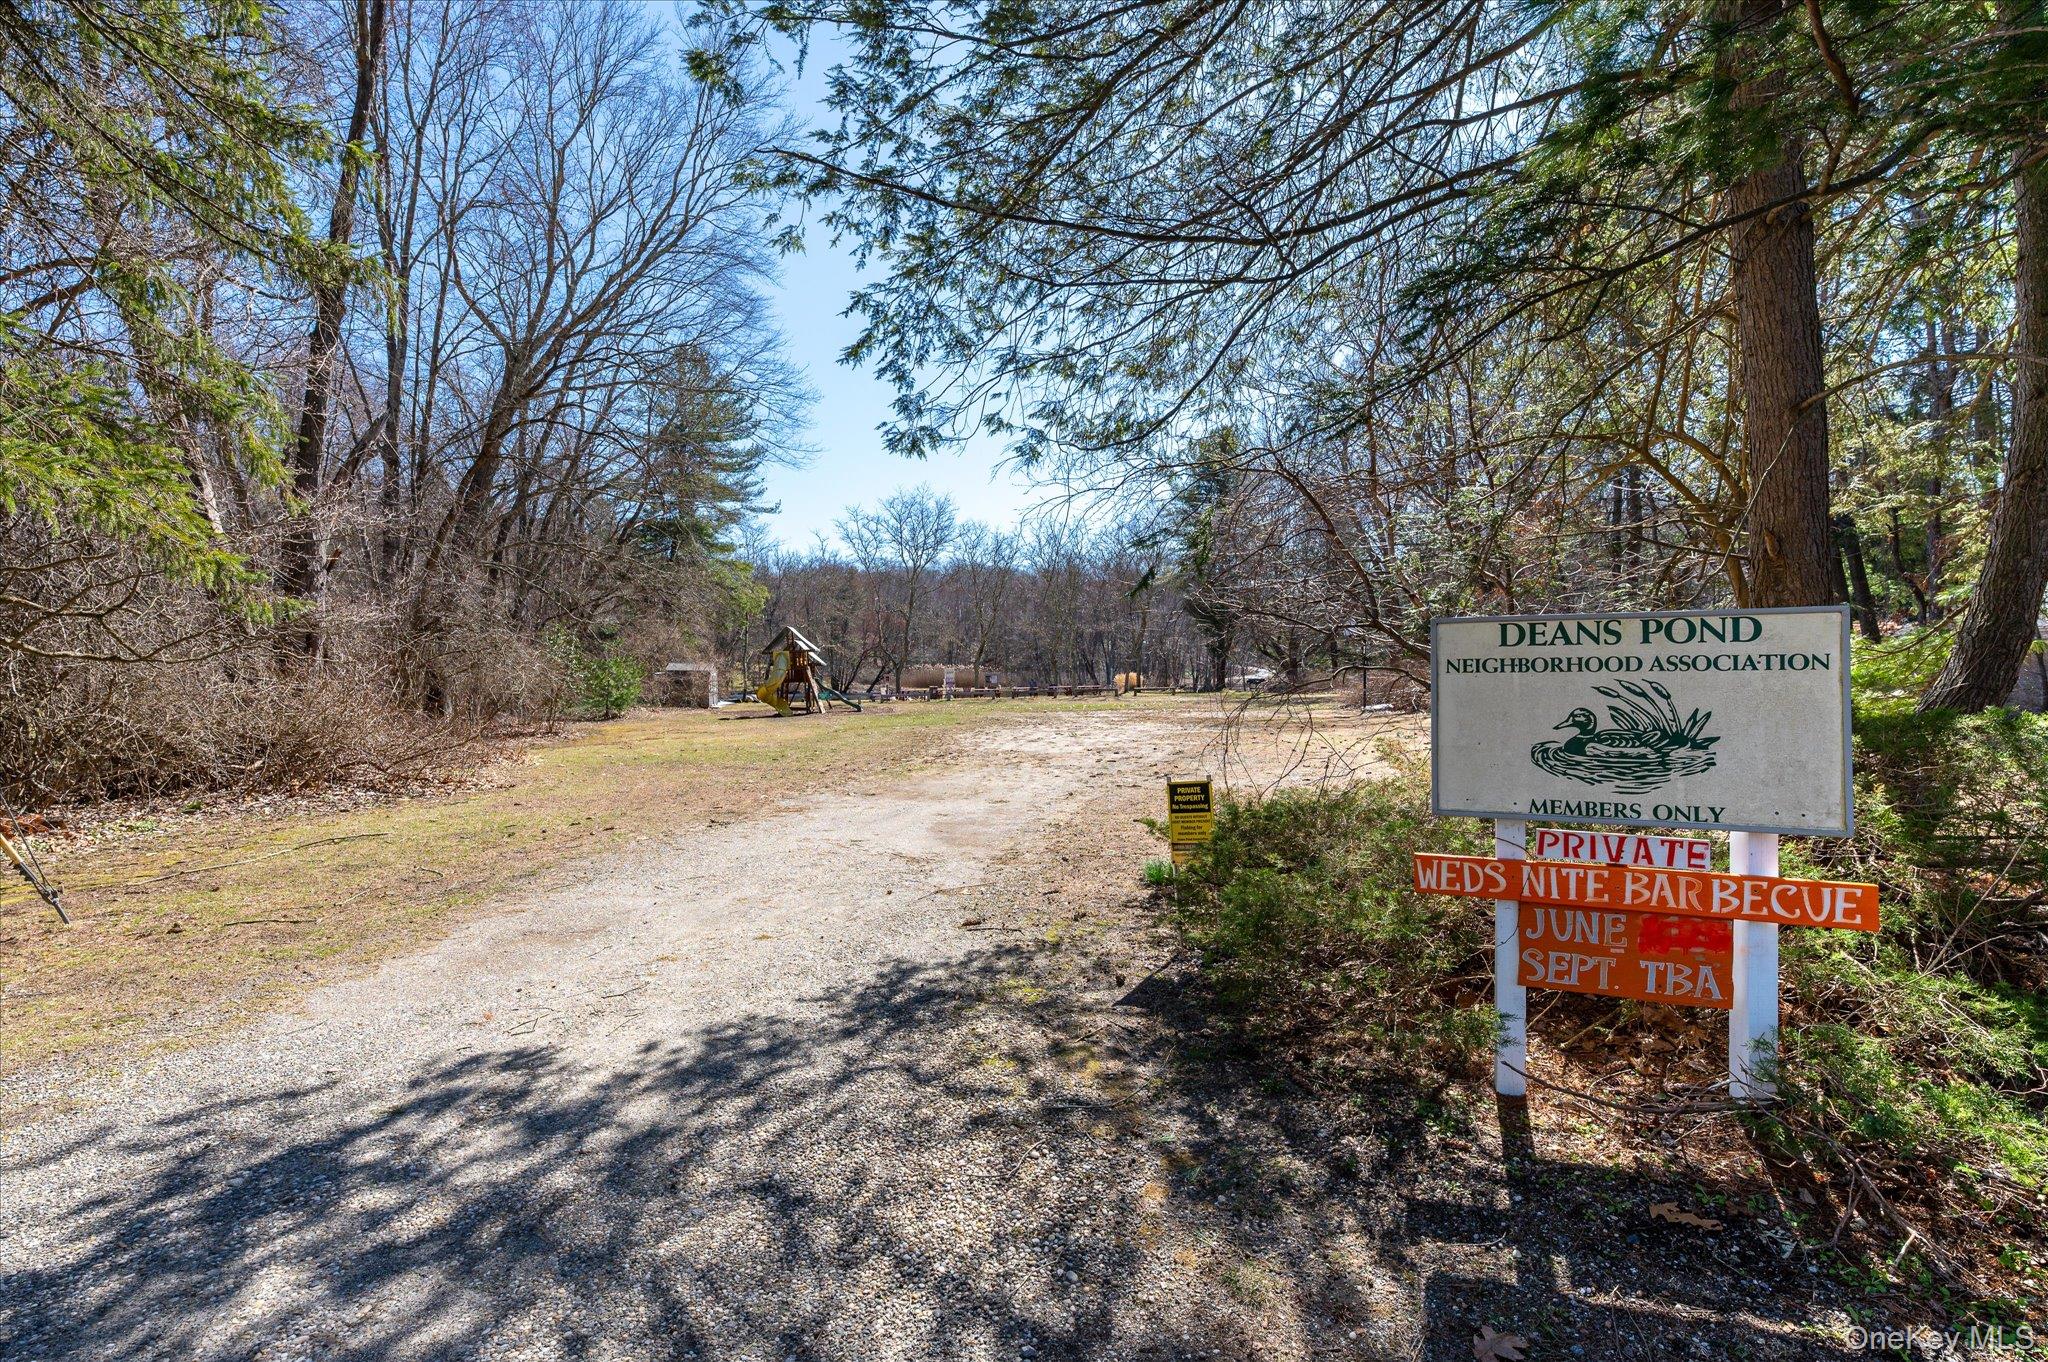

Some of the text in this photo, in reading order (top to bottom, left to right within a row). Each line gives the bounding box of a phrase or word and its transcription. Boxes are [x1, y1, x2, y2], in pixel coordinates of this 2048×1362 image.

[1498, 616, 1763, 648] DEANS POND
[1446, 653, 1832, 674] NEIGHBORHOOD ASSOCIATION
[1529, 798, 1726, 824] MEMBERS ONLY
[1536, 830, 1711, 870] PRIVATE
[1415, 858, 1508, 893] WEDS
[1521, 864, 1610, 902] NITE
[1525, 908, 1628, 948] JUNE
